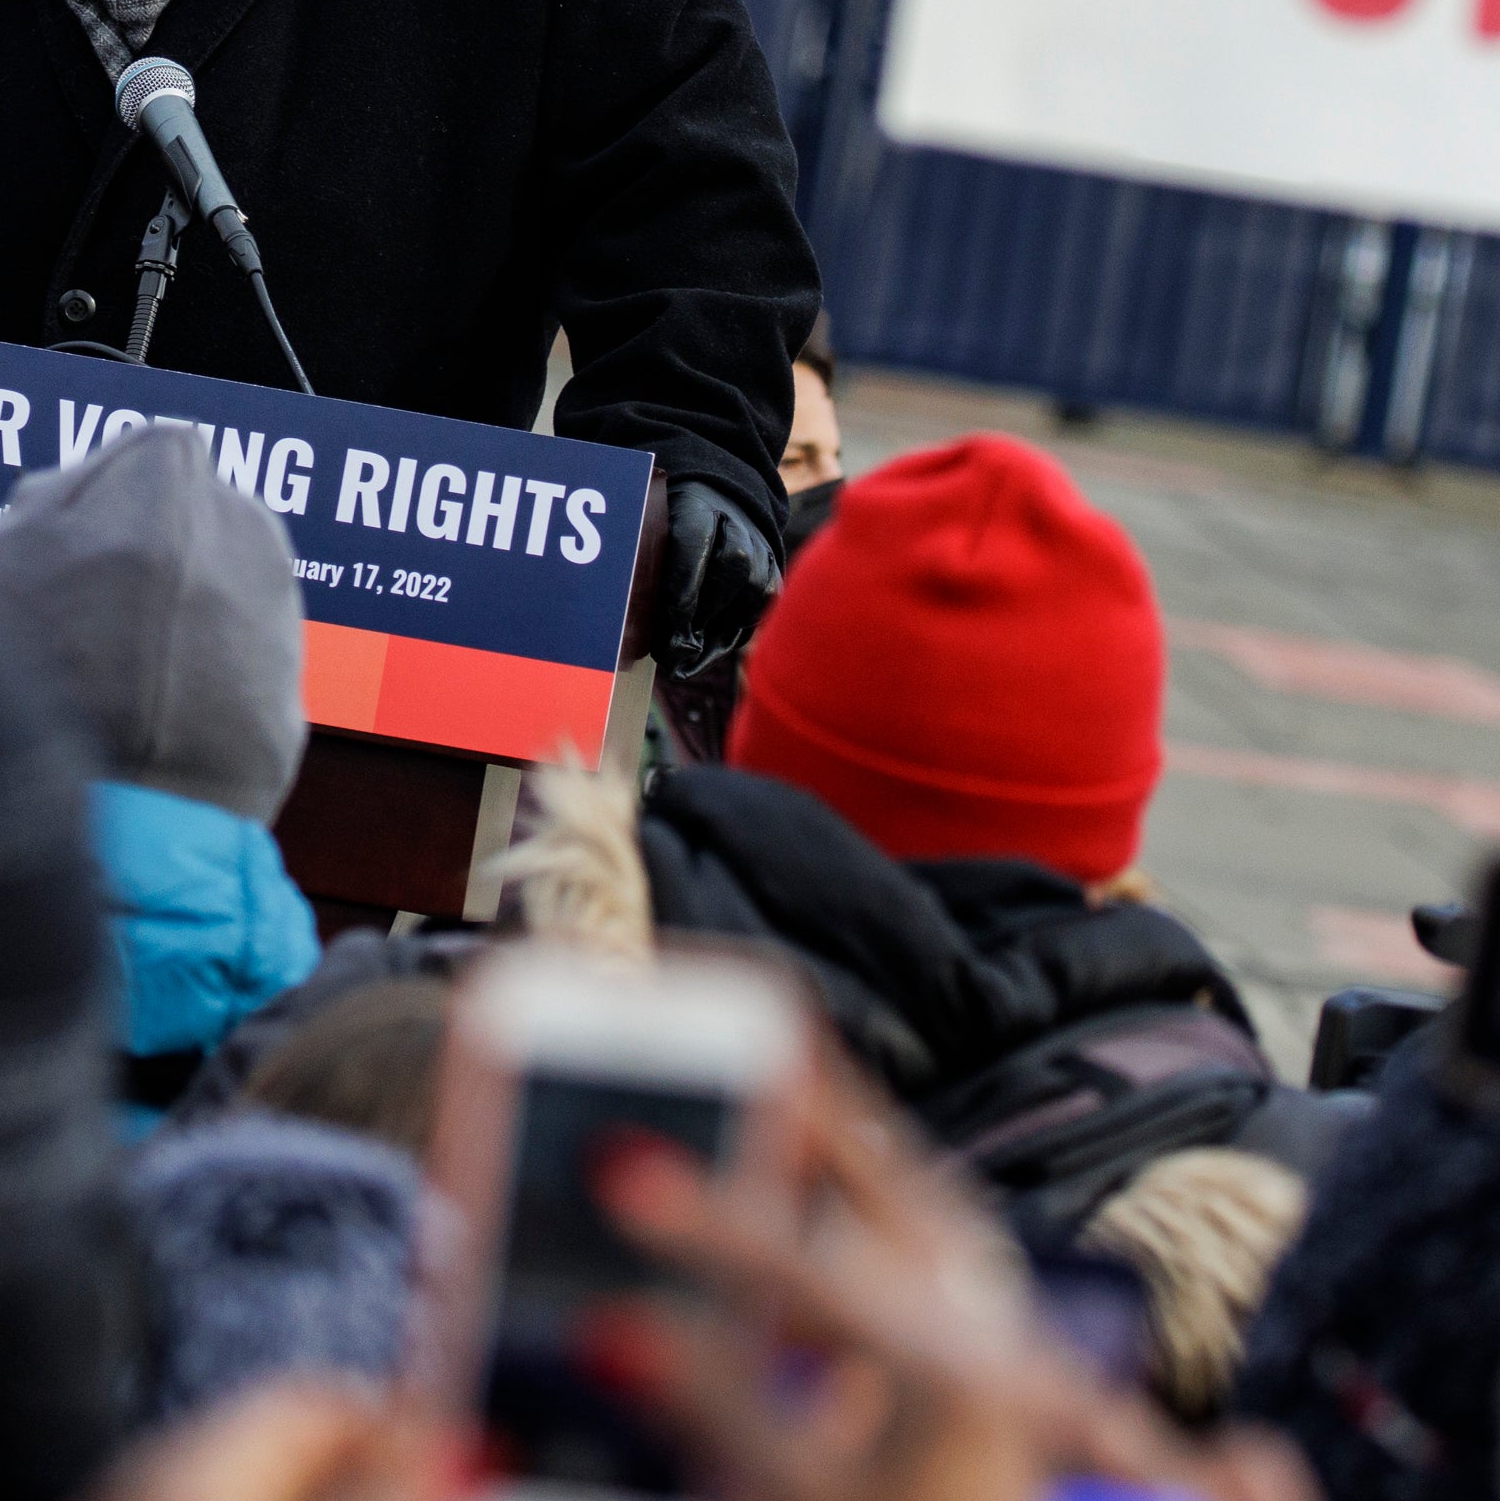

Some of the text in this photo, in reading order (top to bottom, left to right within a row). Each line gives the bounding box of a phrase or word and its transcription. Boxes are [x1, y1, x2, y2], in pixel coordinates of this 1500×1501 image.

[59, 398, 315, 516] VNG
[335, 448, 606, 565] RIGHTS
[291, 557, 345, 588] uary
[353, 562, 383, 595] 17,
[390, 569, 452, 603] 2022
